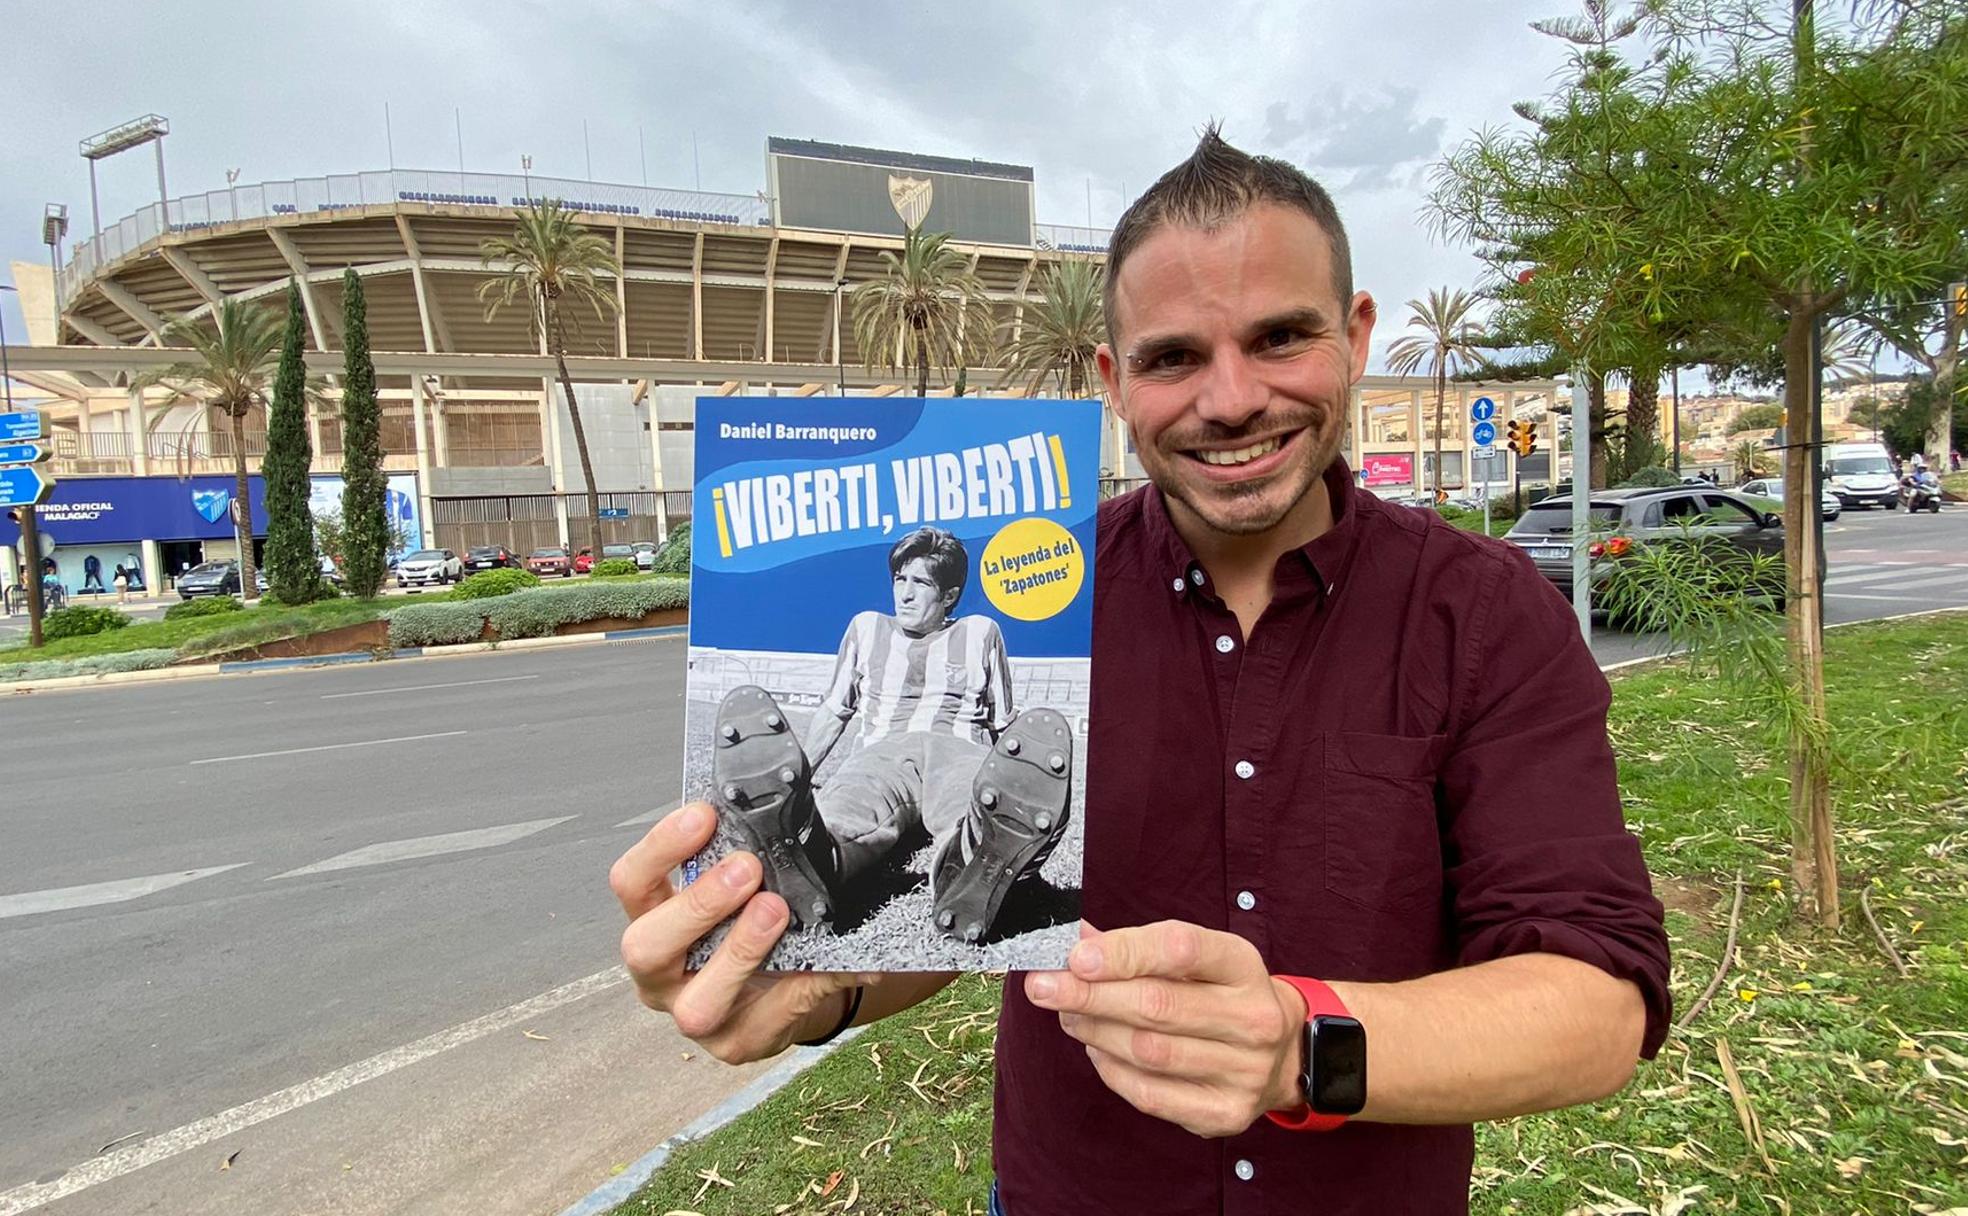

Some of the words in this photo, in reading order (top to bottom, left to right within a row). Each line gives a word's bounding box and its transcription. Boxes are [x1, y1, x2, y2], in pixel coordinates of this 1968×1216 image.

[720, 422, 772, 439] Daniel
[775, 423, 877, 444] Barranquero
[891, 431, 1072, 525] VIBERTI!
[35, 504, 70, 512] IENDA
[71, 502, 114, 511] OFICIAL
[984, 561, 999, 576] La
[1000, 546, 1051, 573] leyenda
[1053, 537, 1075, 557] del
